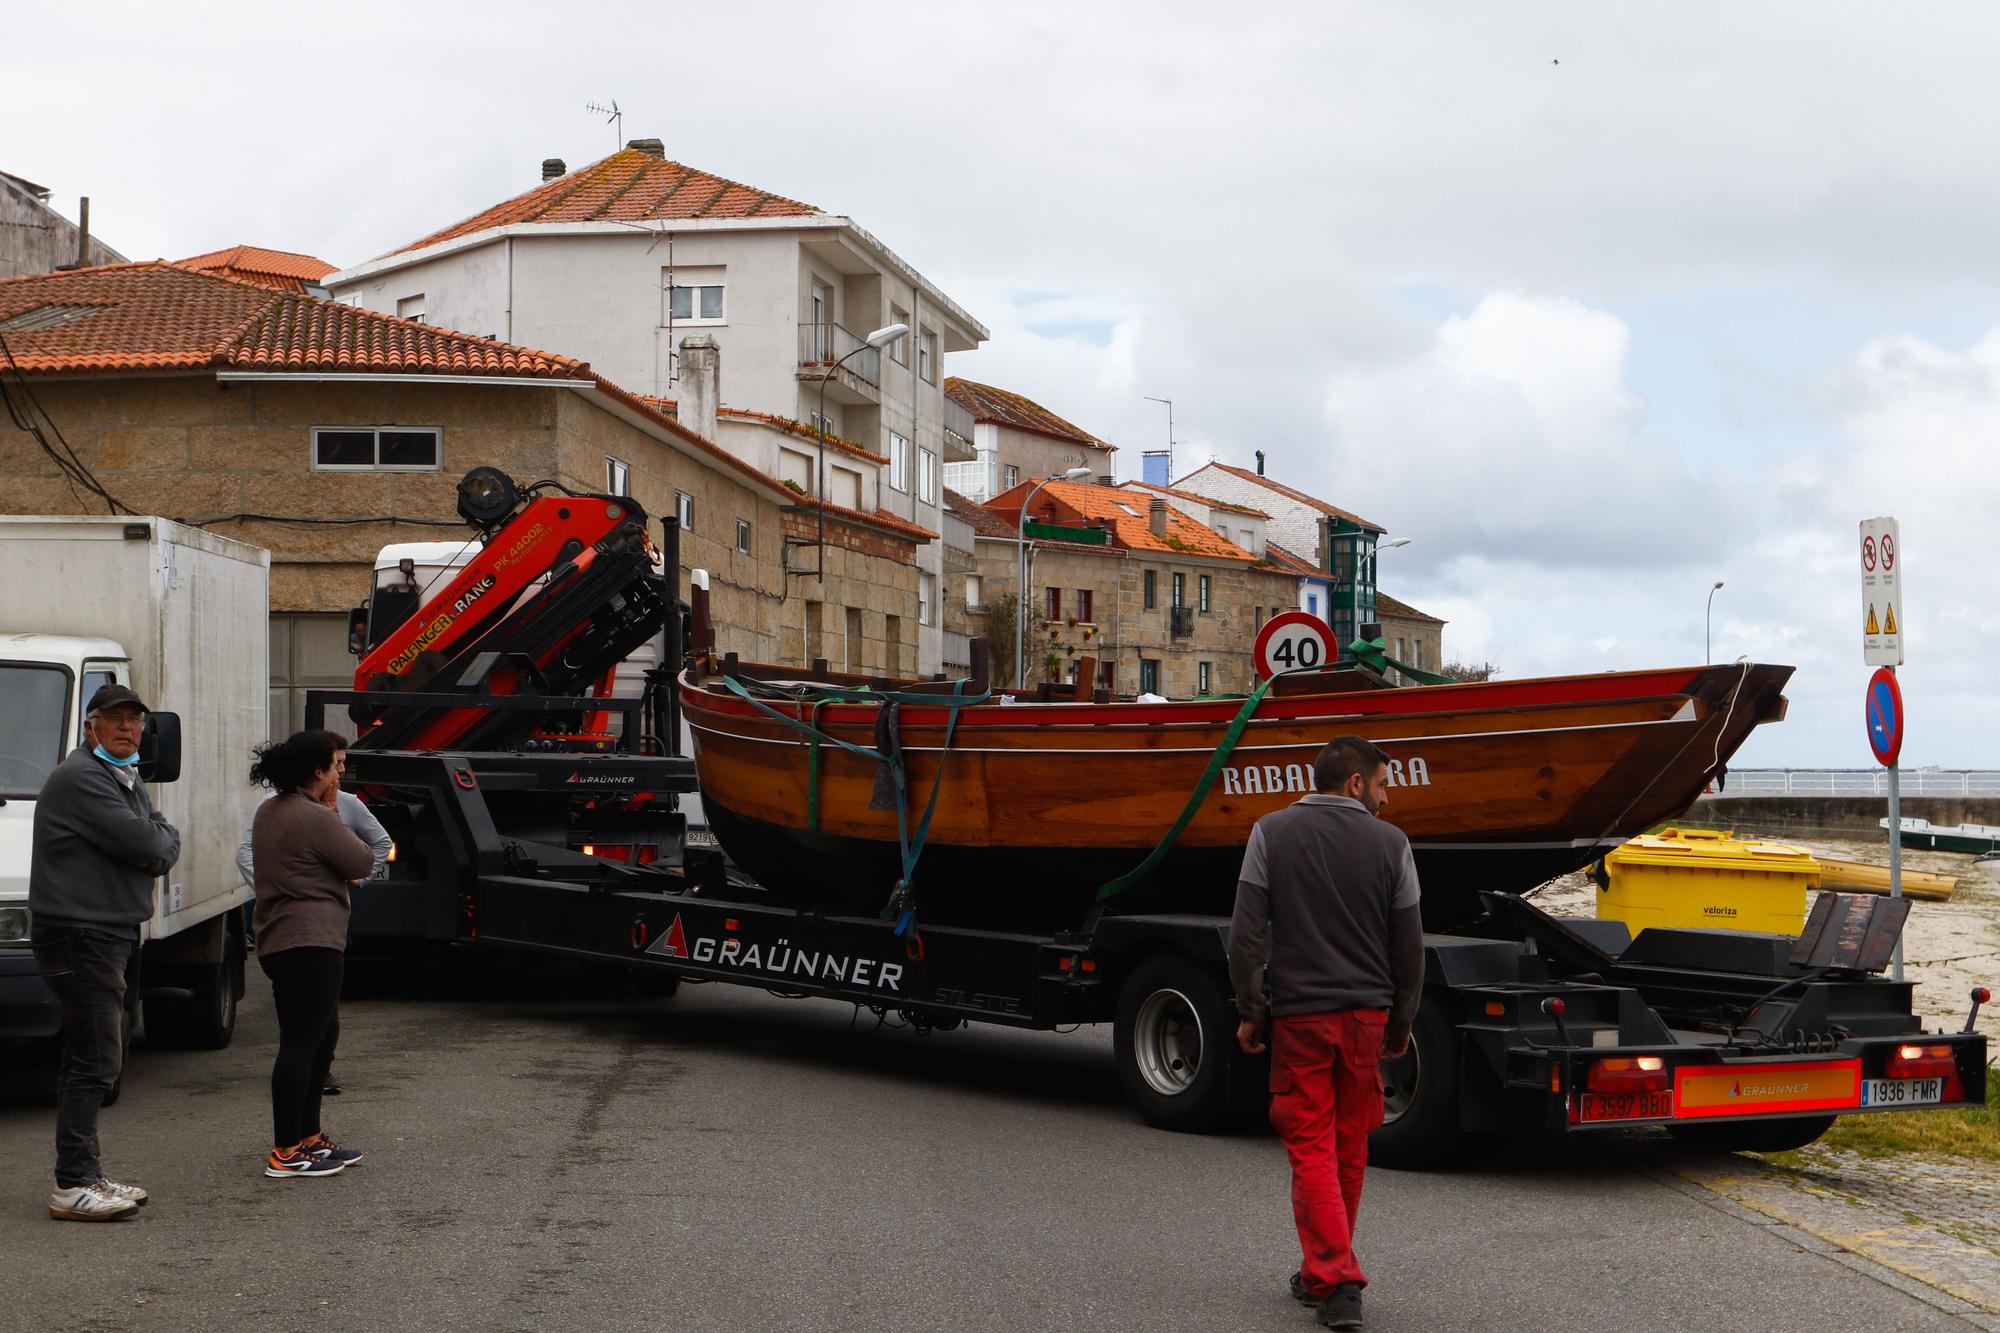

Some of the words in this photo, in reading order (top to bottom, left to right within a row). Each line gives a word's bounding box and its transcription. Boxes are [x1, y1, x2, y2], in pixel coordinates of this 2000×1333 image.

[493, 554, 510, 572] PK
[510, 522, 545, 558] 44002
[390, 614, 451, 673] PALFINGER
[451, 577, 495, 619] RANE
[1273, 637, 1319, 668] 40
[1703, 906, 1737, 915] valoriza
[692, 938, 904, 991] GRAÜNNER
[1583, 1097, 1593, 1118] R
[1599, 1095, 1635, 1117] 3597
[1873, 1081, 1905, 1102] 1936
[1912, 1080, 1938, 1100] FMR
